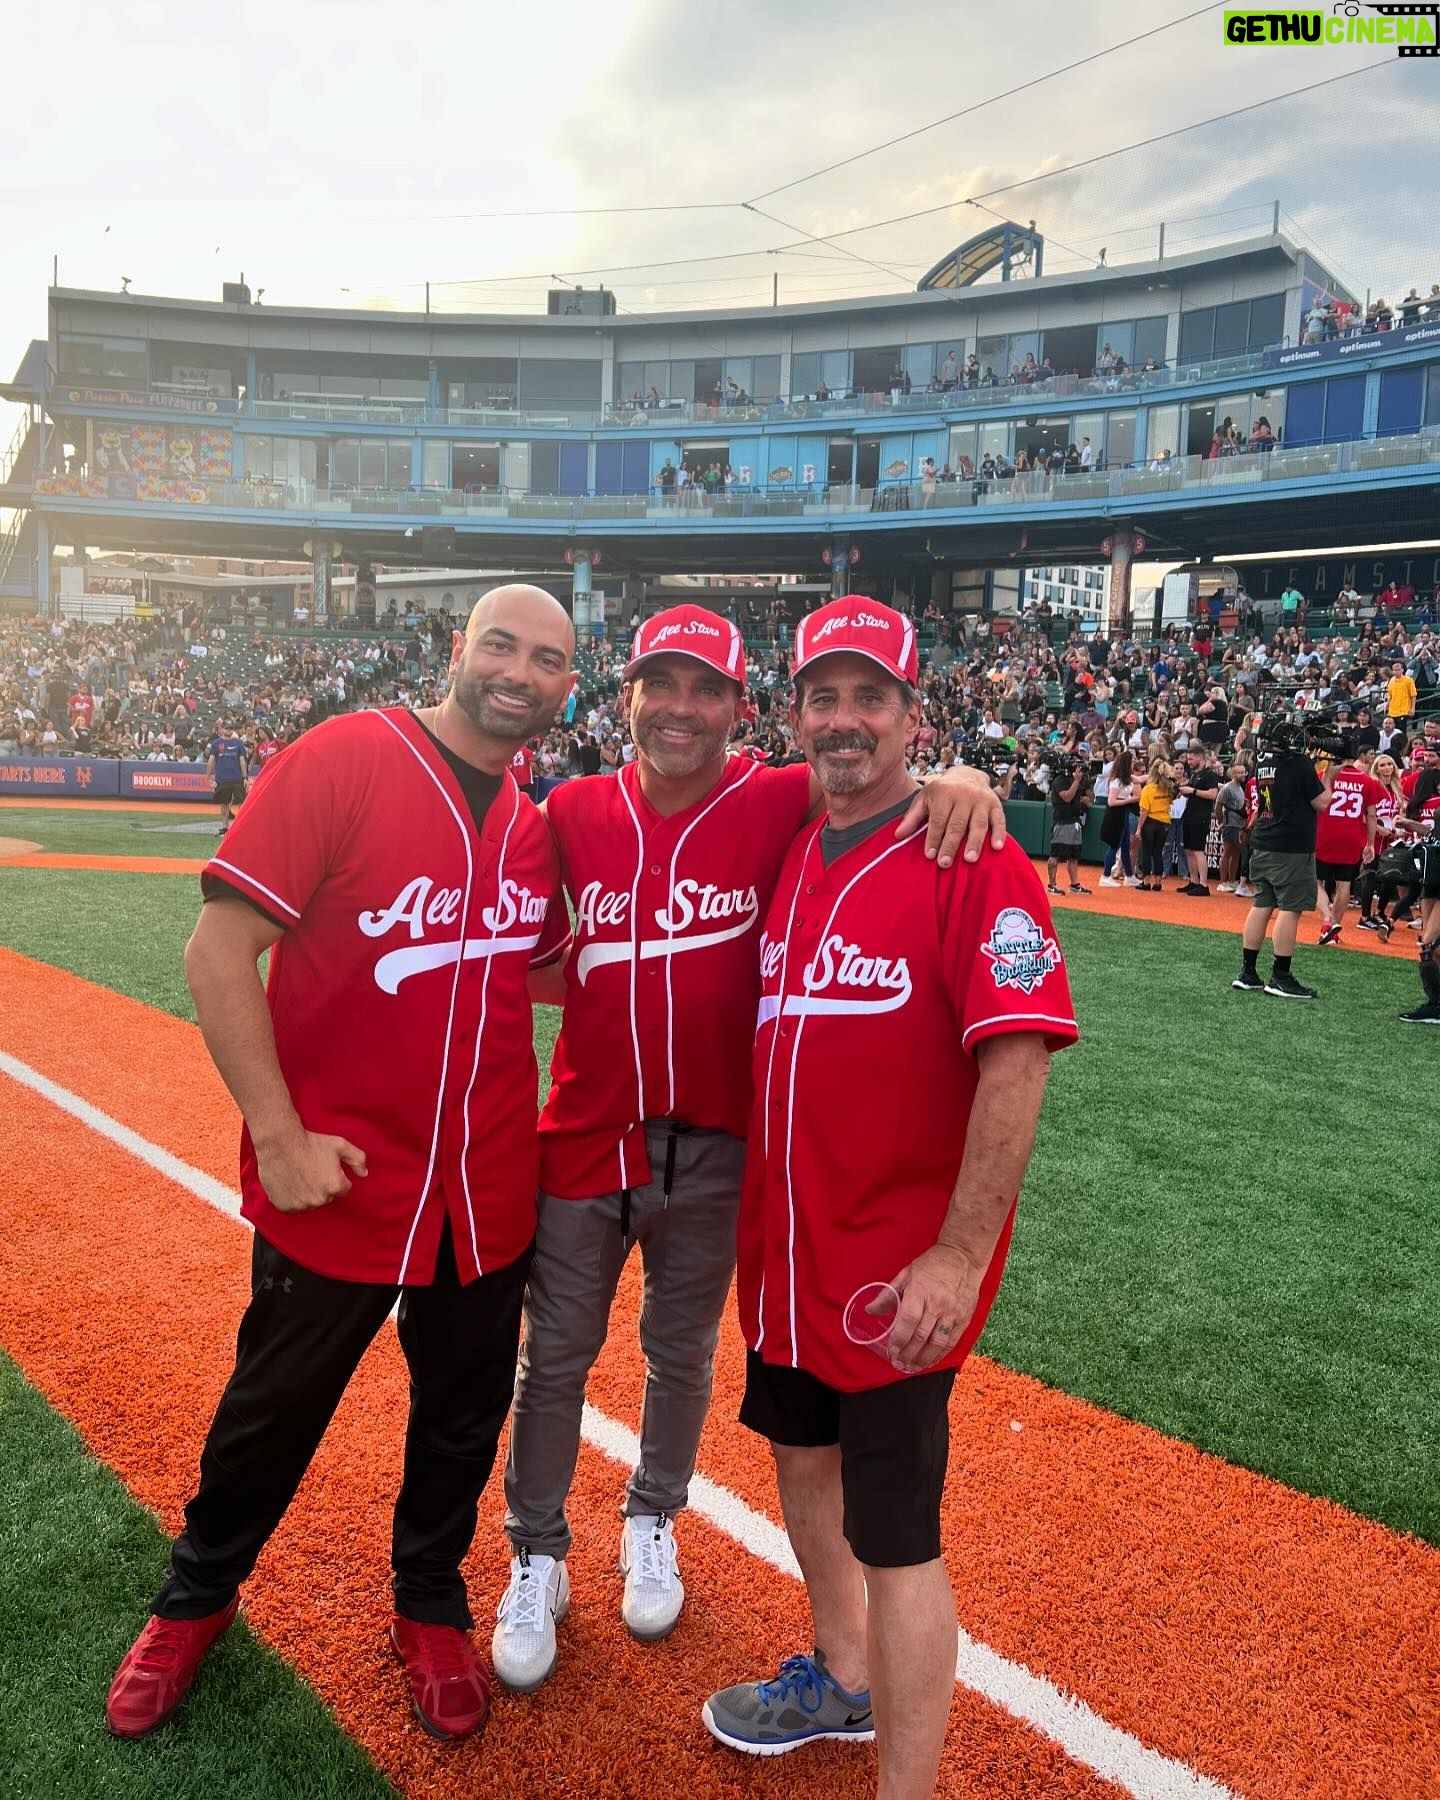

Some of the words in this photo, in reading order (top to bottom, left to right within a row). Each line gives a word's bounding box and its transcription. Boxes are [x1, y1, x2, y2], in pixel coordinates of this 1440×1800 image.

[648, 623, 682, 649] All
[683, 620, 720, 637] Stars
[811, 615, 849, 643] All
[850, 612, 890, 630] Stars
[0, 766, 31, 783] ARTS
[133, 775, 173, 787] BROOKLYN
[1334, 780, 1364, 792] KIRALY
[1329, 791, 1364, 818] 23
[358, 875, 462, 940] All
[482, 879, 549, 932] Star
[576, 880, 631, 937] All
[655, 878, 759, 932] Stars
[803, 934, 911, 991] Stars
